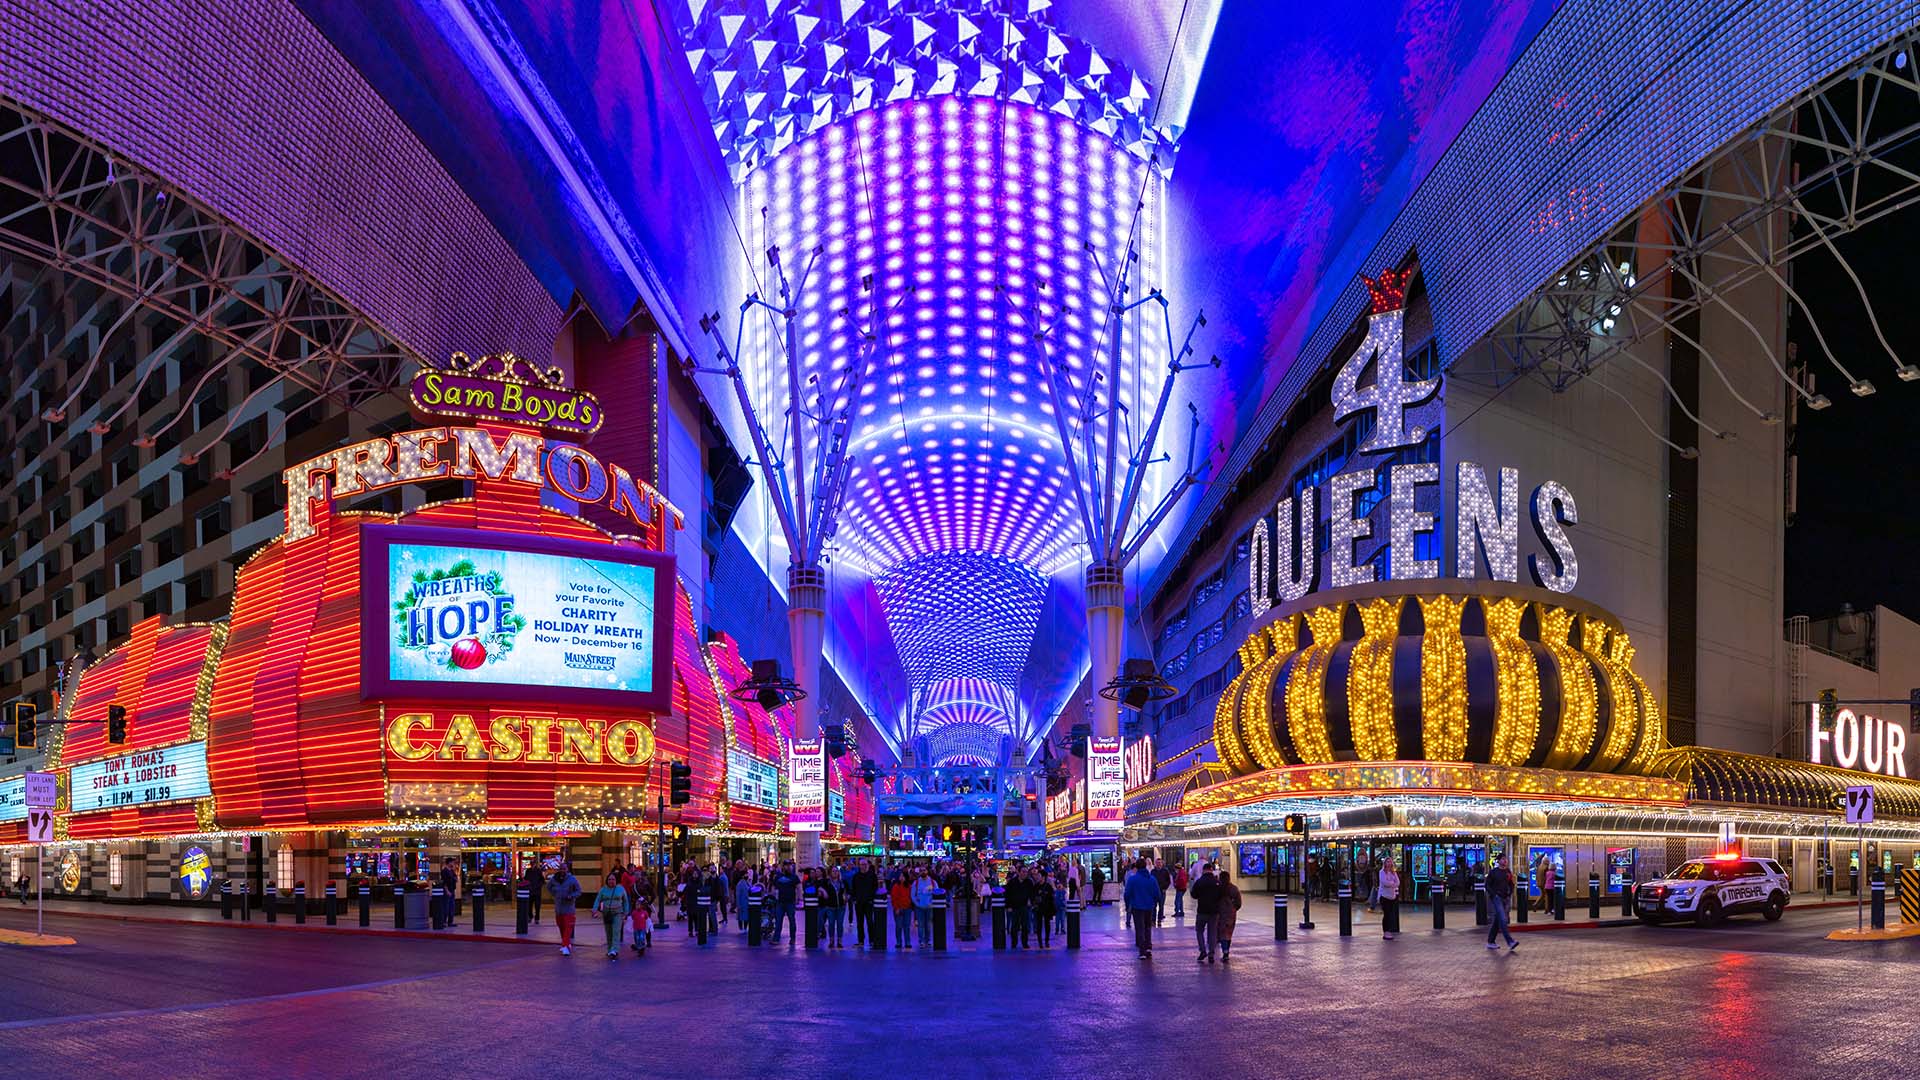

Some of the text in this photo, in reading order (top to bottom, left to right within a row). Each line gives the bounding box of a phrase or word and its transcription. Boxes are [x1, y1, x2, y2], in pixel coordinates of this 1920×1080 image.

[1331, 309, 1443, 456] 4
[422, 374, 594, 425] Sam Boyd's
[282, 426, 686, 553] FREMONT
[1250, 462, 1578, 620] QUEENS
[413, 575, 496, 598] WREATHS
[569, 582, 612, 595] Vote for
[555, 594, 625, 607] your Favorite
[406, 594, 516, 647] HOPE
[561, 607, 617, 622] CHARITY
[534, 619, 643, 639] HOLIDAY WREATH
[534, 633, 560, 644] Now
[571, 636, 628, 650] December
[631, 641, 643, 651] 16
[386, 712, 656, 767] CASINO
[104, 750, 164, 774] TONY ROMA'S
[791, 757, 822, 768] TIME
[1089, 755, 1121, 766] TIME
[1124, 734, 1152, 791] SINO
[93, 764, 177, 789] STEAK & LOBSTER
[794, 772, 825, 781] LIFE
[1093, 771, 1125, 780] LIFE
[32, 785, 49, 794] MUST
[97, 795, 103, 807] 9
[121, 790, 133, 805] PM
[144, 786, 170, 802] $11.99
[1091, 789, 1121, 800] TICKETS
[793, 798, 822, 807] TAG TEAM
[1090, 798, 1122, 808] ON SALE
[1096, 808, 1119, 819] NOW
[1727, 886, 1767, 900] MARSHAL
